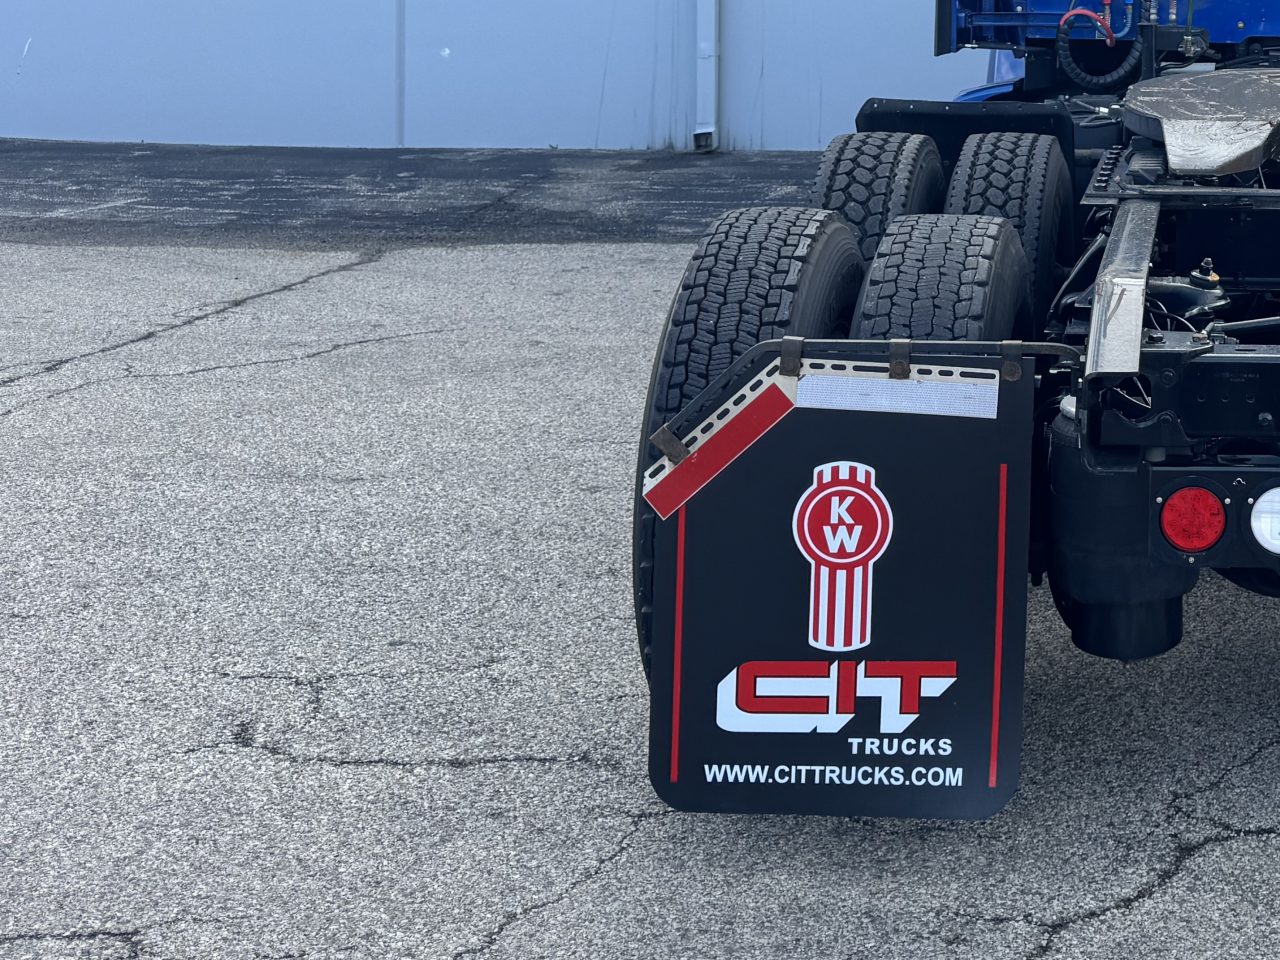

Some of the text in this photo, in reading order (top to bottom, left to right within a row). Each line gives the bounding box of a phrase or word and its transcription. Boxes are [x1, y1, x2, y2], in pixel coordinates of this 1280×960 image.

[717, 659, 958, 734] CIT
[848, 738, 953, 755] TRUCKS
[704, 764, 963, 786] WWW.CITTRUCKS.COM
